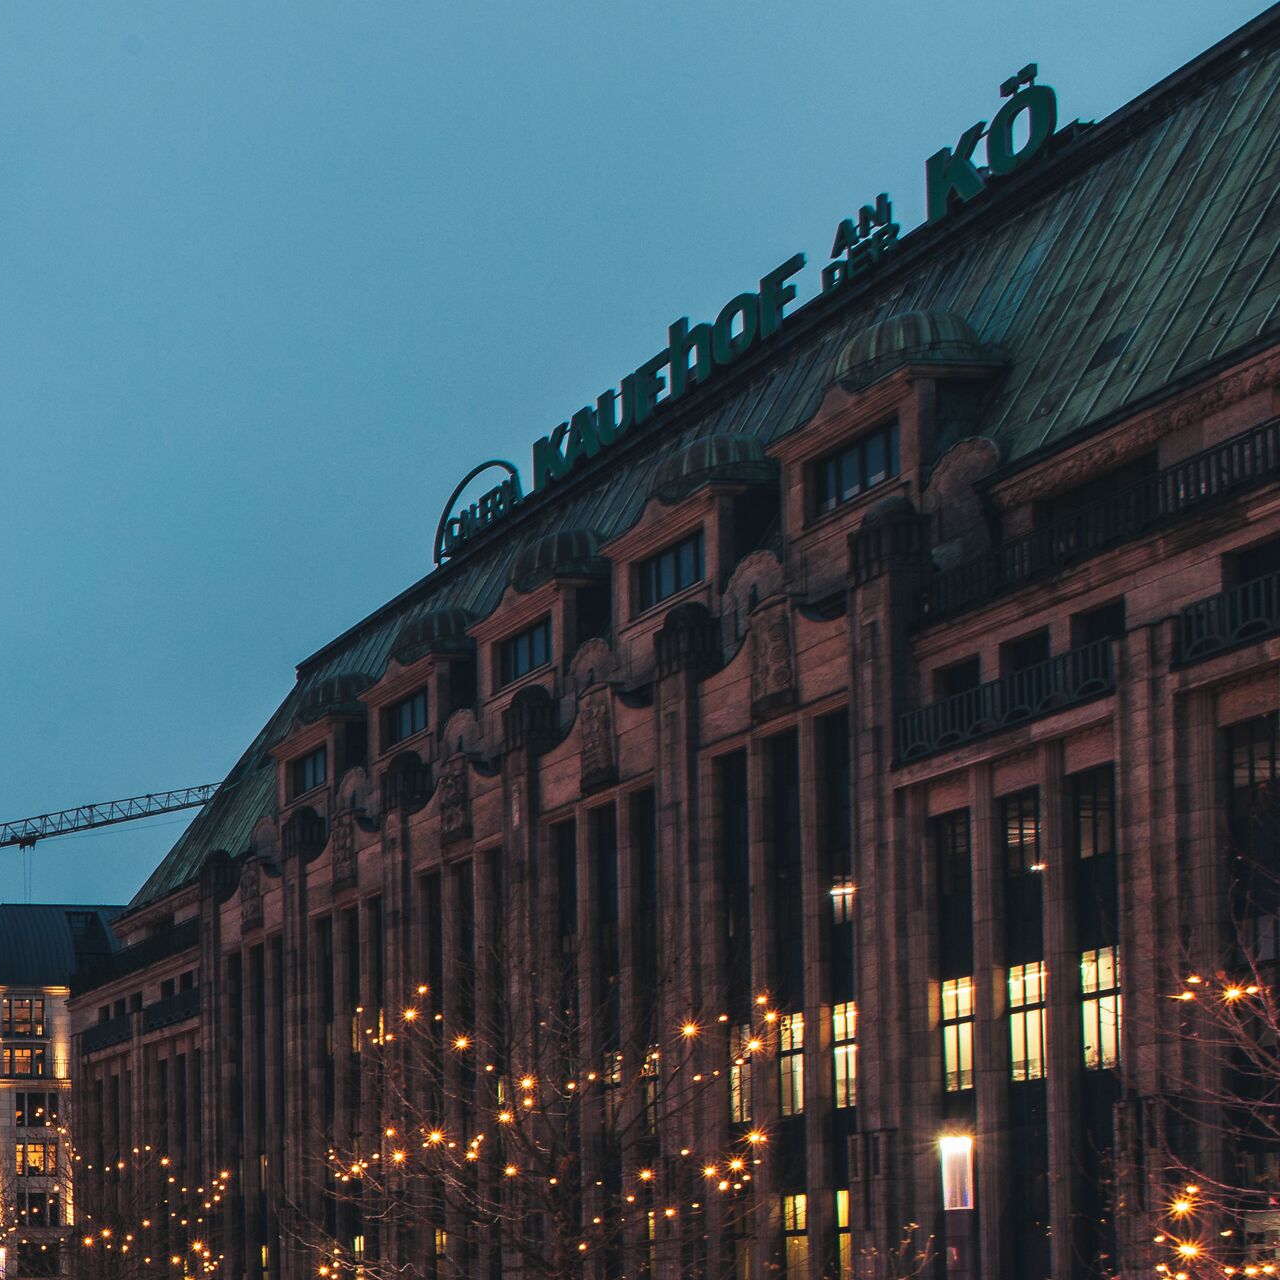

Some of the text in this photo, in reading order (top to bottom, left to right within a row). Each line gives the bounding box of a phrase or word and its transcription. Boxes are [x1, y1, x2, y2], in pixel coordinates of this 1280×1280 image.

[925, 62, 1057, 224] KÖ
[821, 222, 900, 297] DER
[830, 192, 891, 259] AN
